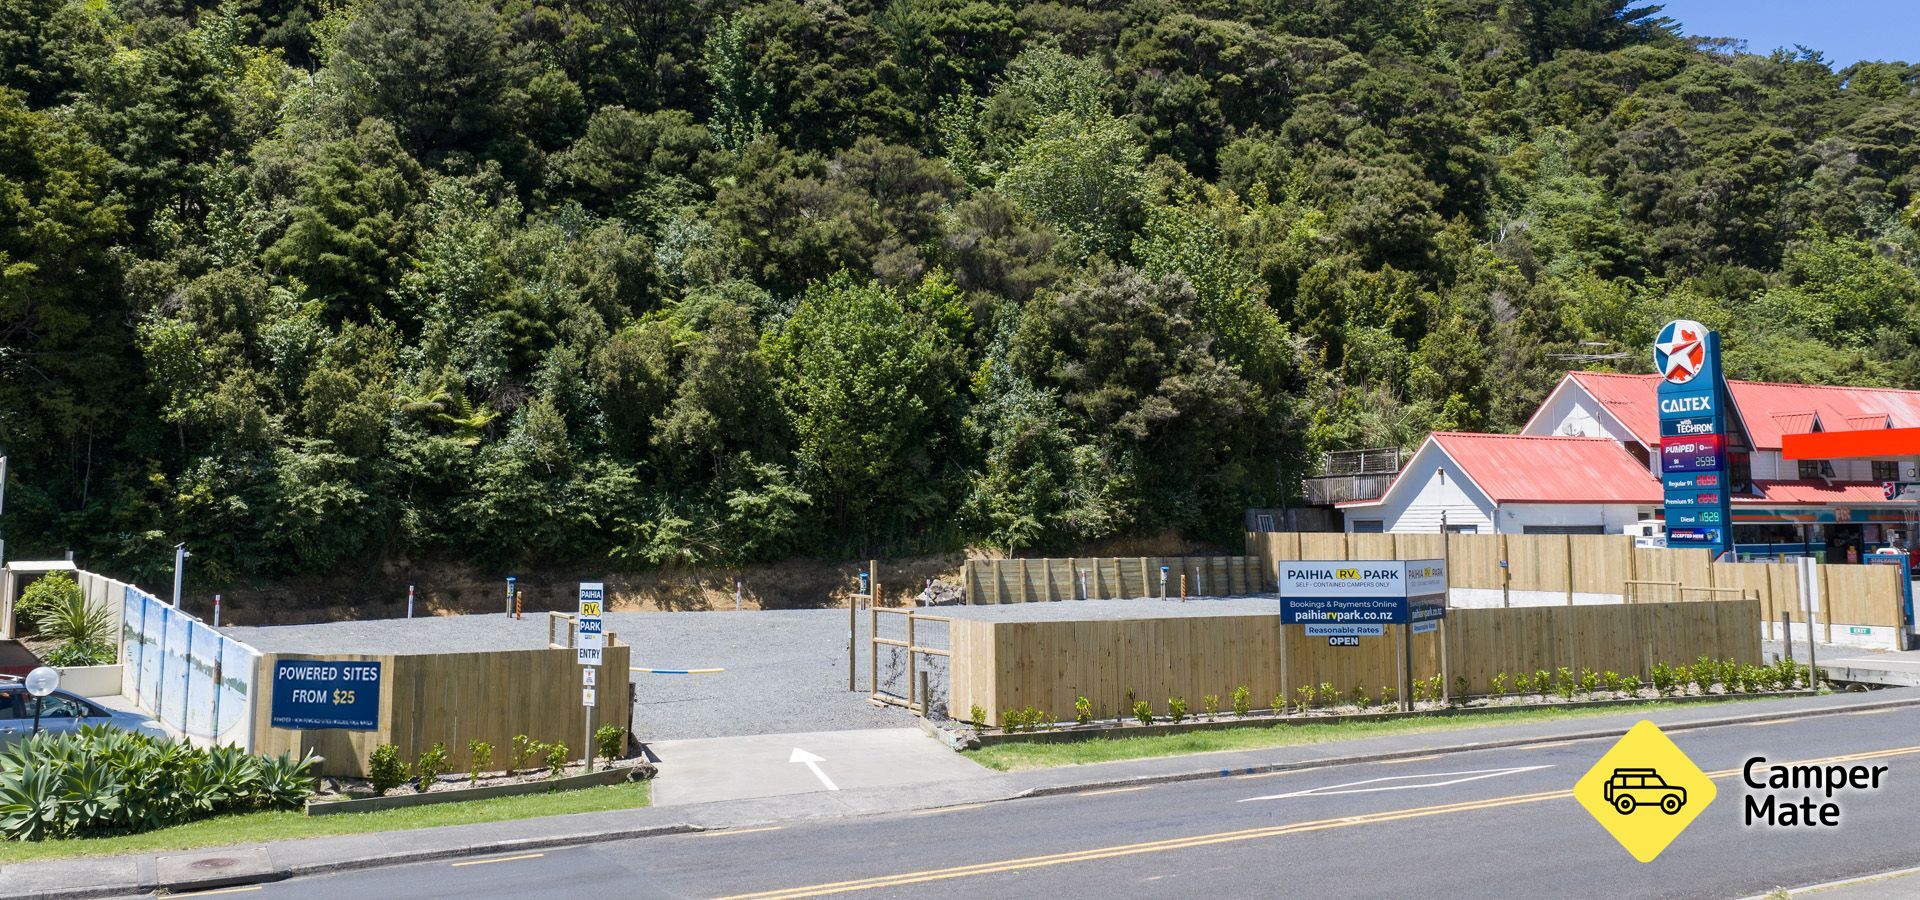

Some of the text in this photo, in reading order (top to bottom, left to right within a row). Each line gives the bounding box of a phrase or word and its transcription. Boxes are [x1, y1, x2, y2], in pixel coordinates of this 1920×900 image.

[1661, 396, 1711, 413] CALTEX
[1676, 423, 1713, 434] TECHRON
[1665, 444, 1695, 454] PUMPED
[1287, 569, 1399, 580] PAIHIA RV PARK
[581, 590, 601, 599] PAIHIA
[583, 604, 596, 613] RV
[1290, 601, 1325, 609] Bookings
[1333, 601, 1371, 609] Payments
[1295, 610, 1393, 622] paihiarvpark.co.nz
[580, 621, 601, 631] PARK
[1308, 626, 1379, 634] Reasonable Rates
[1329, 637, 1359, 646] OPEN
[580, 648, 601, 659] ENTRY
[278, 666, 378, 681] POWERED SITES
[292, 688, 355, 706] FROM $25
